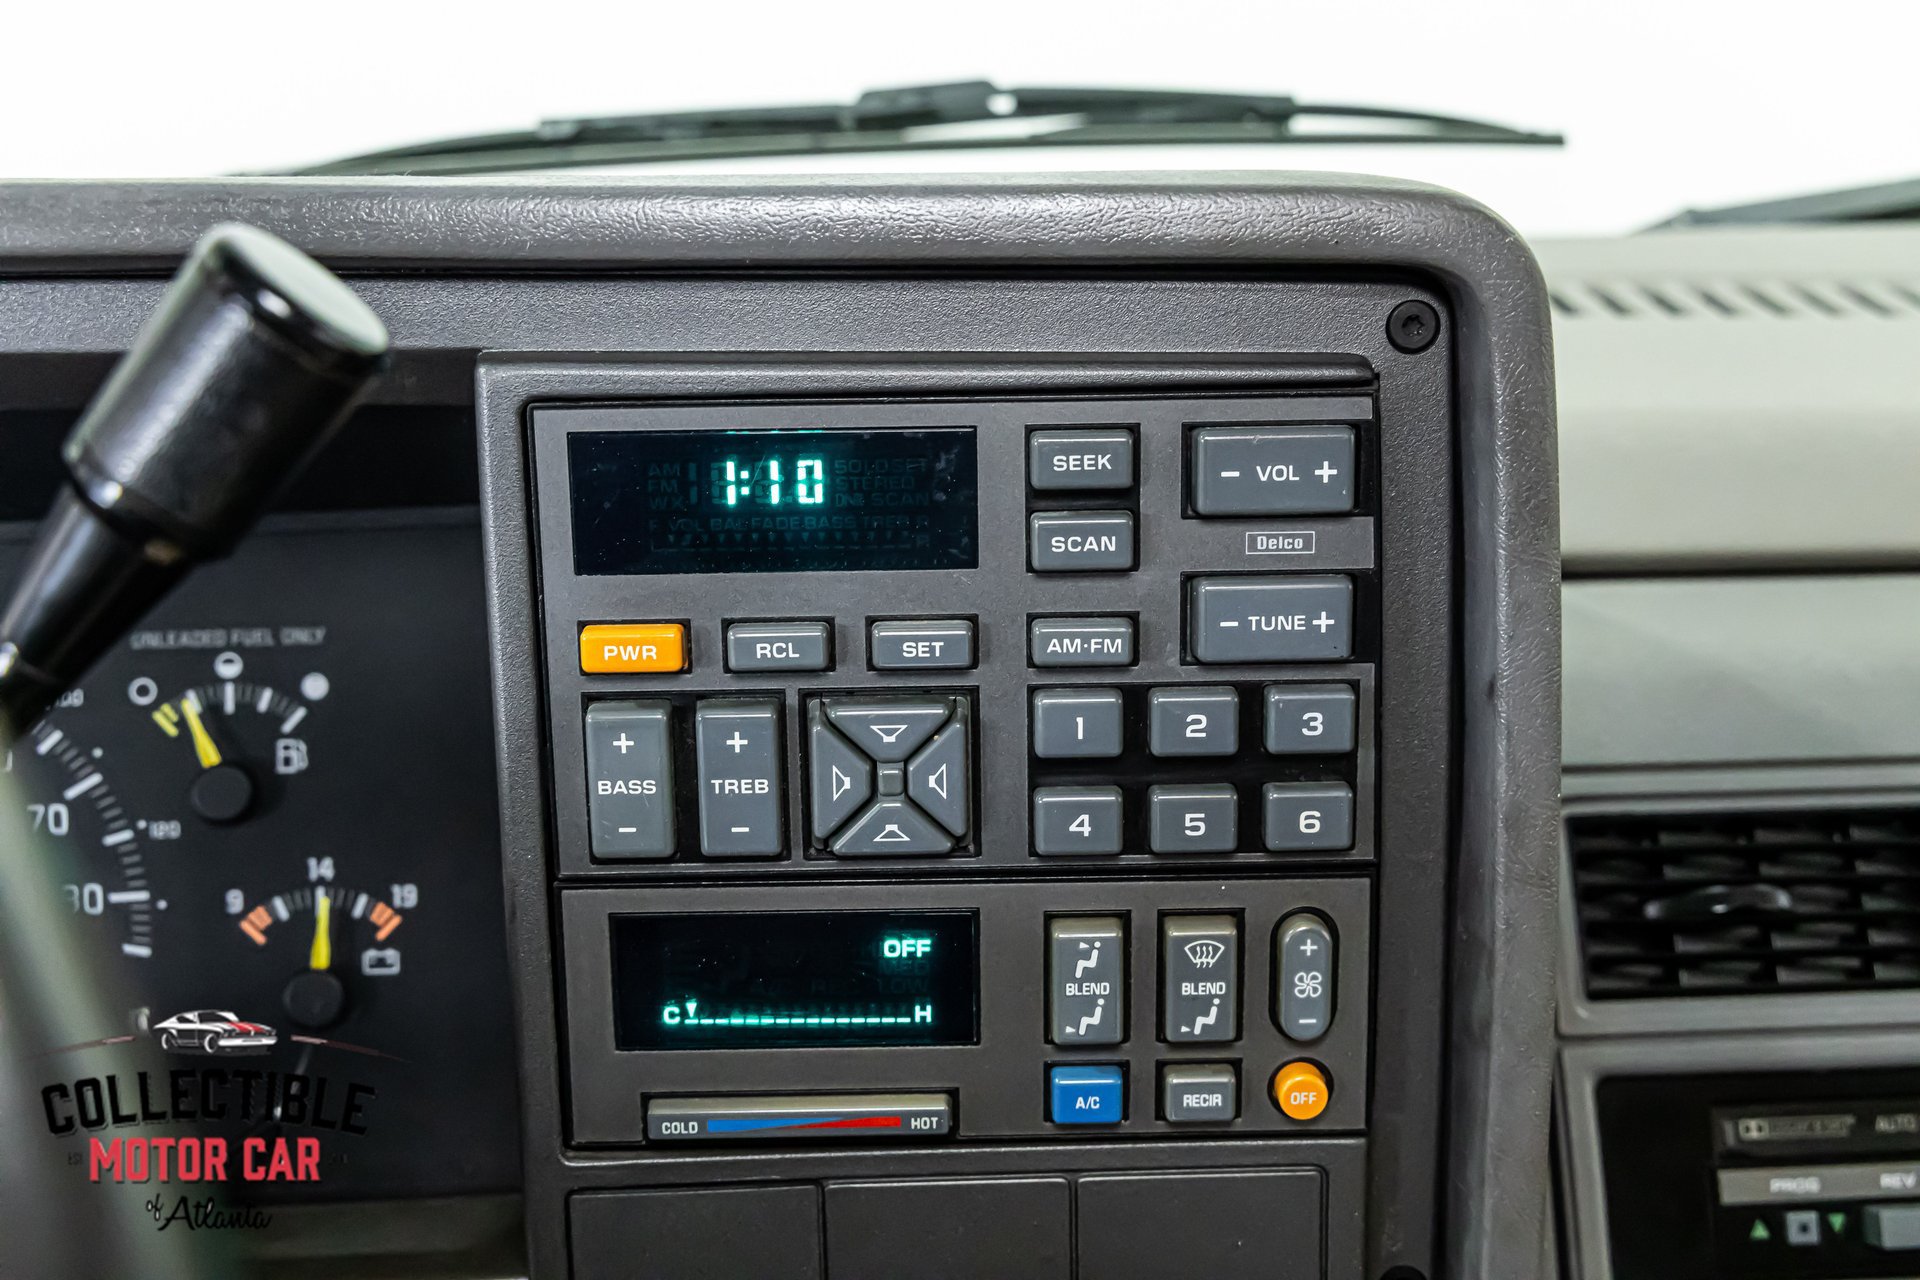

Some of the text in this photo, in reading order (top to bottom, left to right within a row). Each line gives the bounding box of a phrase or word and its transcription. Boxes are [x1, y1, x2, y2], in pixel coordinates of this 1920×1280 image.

[1052, 453, 1113, 472] SEEK
[725, 459, 824, 505] 1:10
[1255, 464, 1300, 482] VOL
[1050, 535, 1117, 553] SCAN
[1256, 535, 1305, 551] Delco
[1247, 615, 1307, 631] TUNE
[130, 625, 326, 649] UNLEADED FUEL ONLY
[603, 644, 658, 661] PWR
[755, 642, 801, 659] RCL
[901, 641, 945, 658] SET
[1075, 716, 1085, 740] 1
[1184, 713, 1208, 738] 2
[1301, 711, 1324, 737] 3
[597, 779, 657, 795] BASS
[710, 778, 770, 795] TREB
[27, 802, 70, 836] 70
[1068, 813, 1092, 838] 4
[1184, 812, 1207, 837] 5
[1299, 810, 1322, 835] 6
[306, 856, 335, 883] 14
[224, 888, 244, 915] 9
[389, 883, 419, 910] 19
[883, 938, 932, 959] OFF
[1065, 982, 1110, 997] BLEND
[1181, 981, 1226, 996] BLEND
[662, 1004, 933, 1026] C H
[1075, 1095, 1101, 1111] A/C
[1182, 1093, 1223, 1108] RECIR
[1290, 1092, 1318, 1106] OFF
[661, 1120, 699, 1136] COLD
[910, 1116, 939, 1131] HOT
